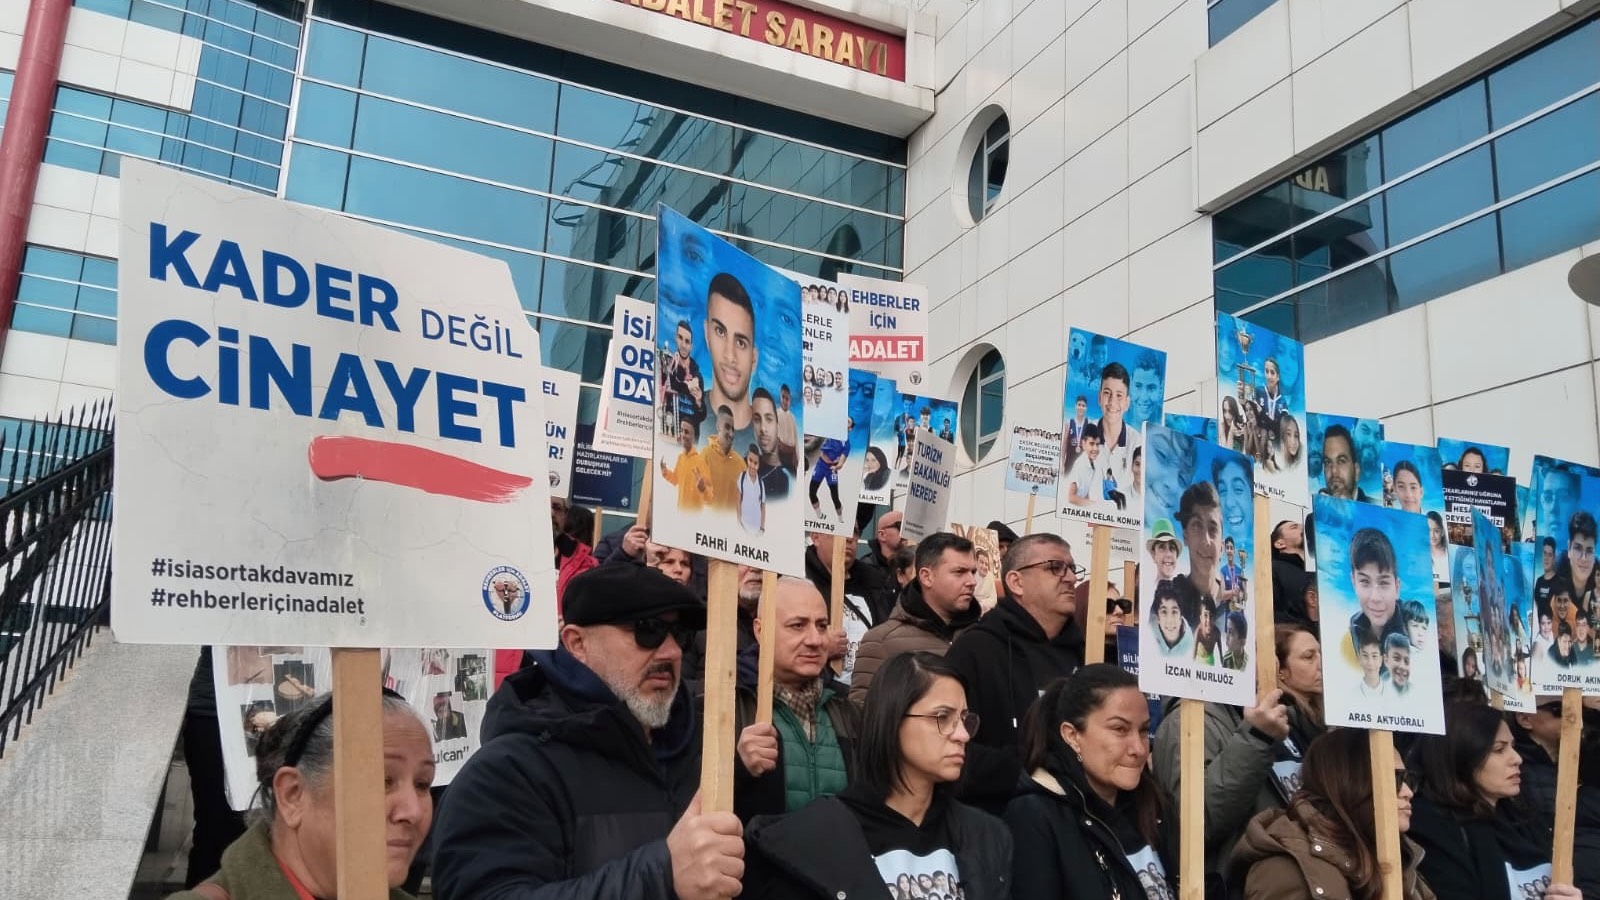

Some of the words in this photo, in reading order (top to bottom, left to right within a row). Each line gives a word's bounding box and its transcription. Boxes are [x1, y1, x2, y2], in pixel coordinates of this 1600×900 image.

[763, 10, 888, 75] SARAYI
[149, 222, 401, 332] KADER
[421, 309, 523, 359] DEĞİL
[849, 288, 920, 312] EHBERLER
[623, 309, 655, 342] İSİ
[870, 310, 897, 330] İÇİN
[801, 327, 833, 343] NLER
[849, 338, 921, 360] ADALET
[619, 373, 654, 401] DA
[917, 441, 943, 465] TURİZM
[913, 461, 951, 488] BAKANLIĞI
[910, 481, 938, 504] NEREDE
[1062, 507, 1091, 518] ATAKAN
[1093, 512, 1115, 522] CELAL
[1117, 516, 1141, 526] KONUK
[695, 532, 728, 552] FAHRİ
[734, 543, 770, 563] ARKAR
[151, 558, 354, 588] #isiasortakdavamız
[151, 587, 365, 614] #rehberleriçinadalet
[1165, 662, 1191, 678] İZCAN
[1196, 670, 1234, 685] NURLUÖZ
[1557, 673, 1581, 683] DORUK
[1349, 712, 1372, 722] ARAS
[1376, 715, 1425, 728] AKTUĞRALI
